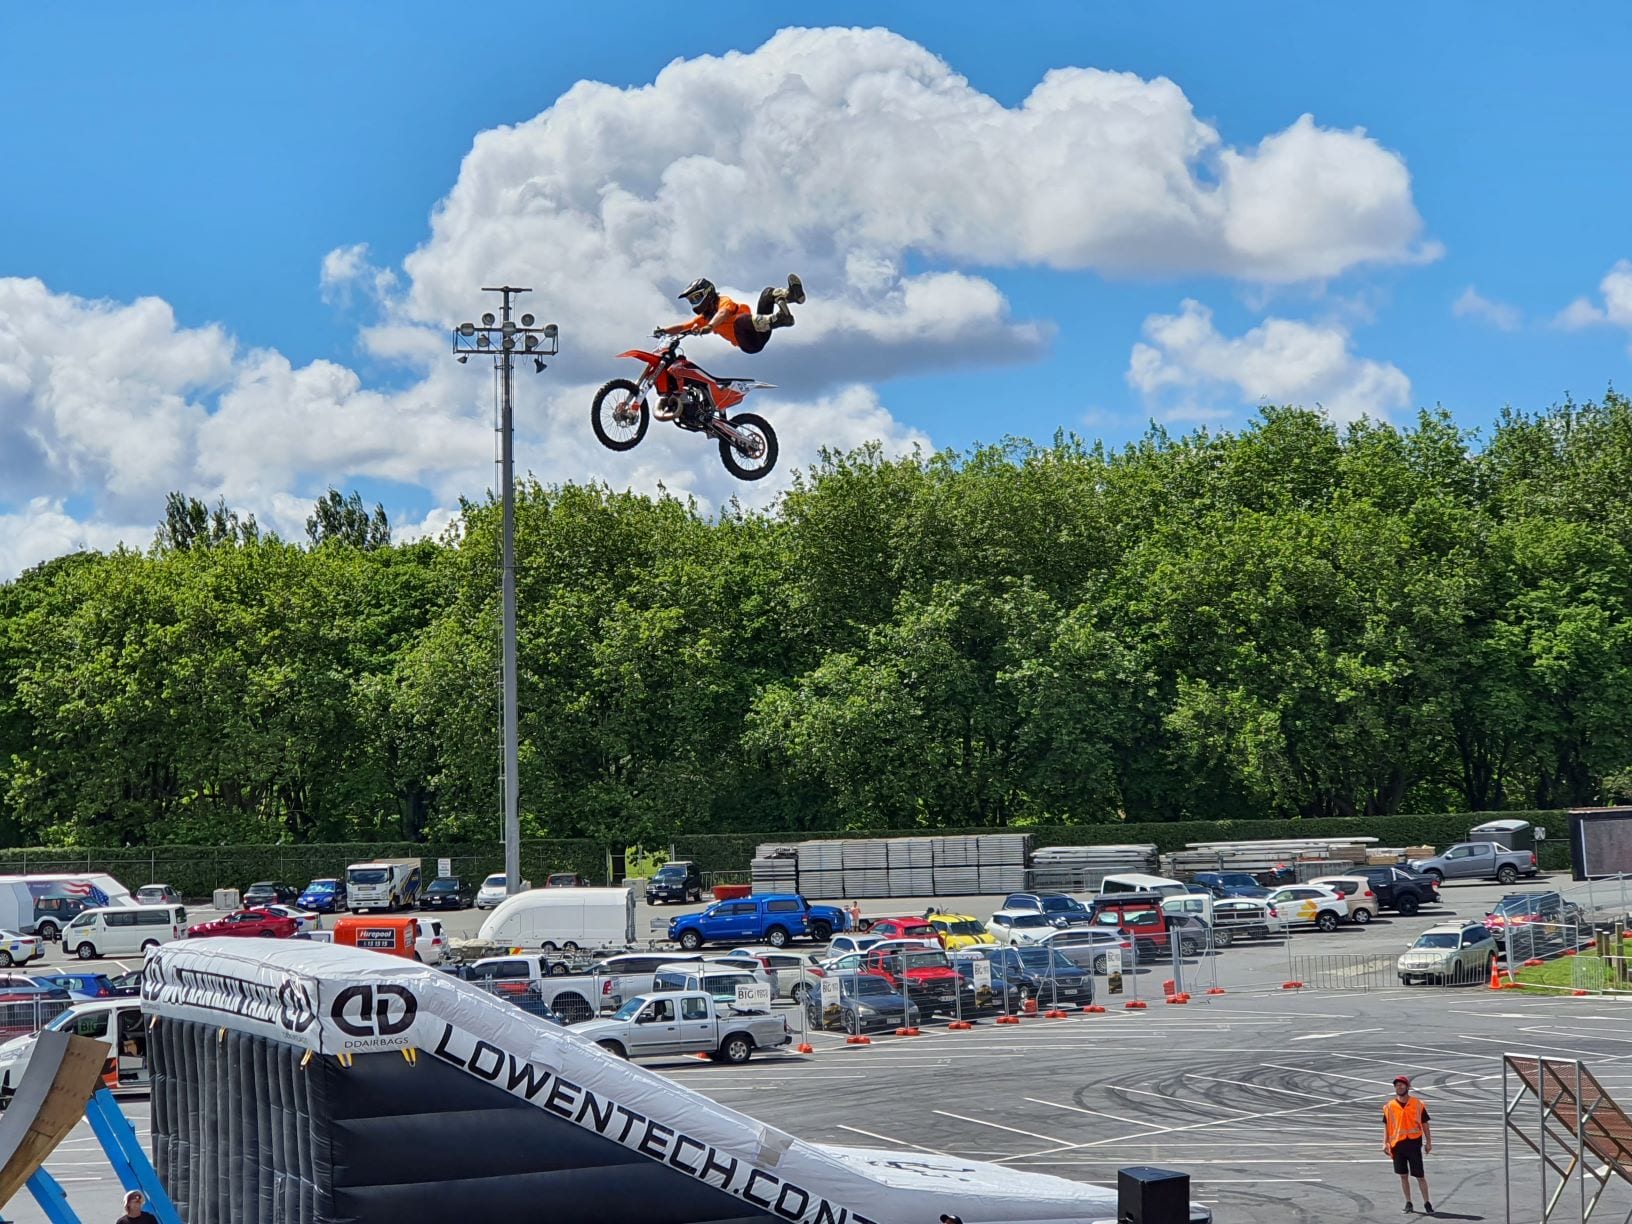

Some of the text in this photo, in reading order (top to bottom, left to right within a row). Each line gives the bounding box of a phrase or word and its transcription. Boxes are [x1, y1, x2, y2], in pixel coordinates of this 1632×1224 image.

[360, 930, 392, 939] Hirepool
[738, 990, 754, 999] BIG
[344, 1036, 409, 1049] DDAIRBAGS
[434, 1022, 878, 1224] LOWENTECH.CO.N
